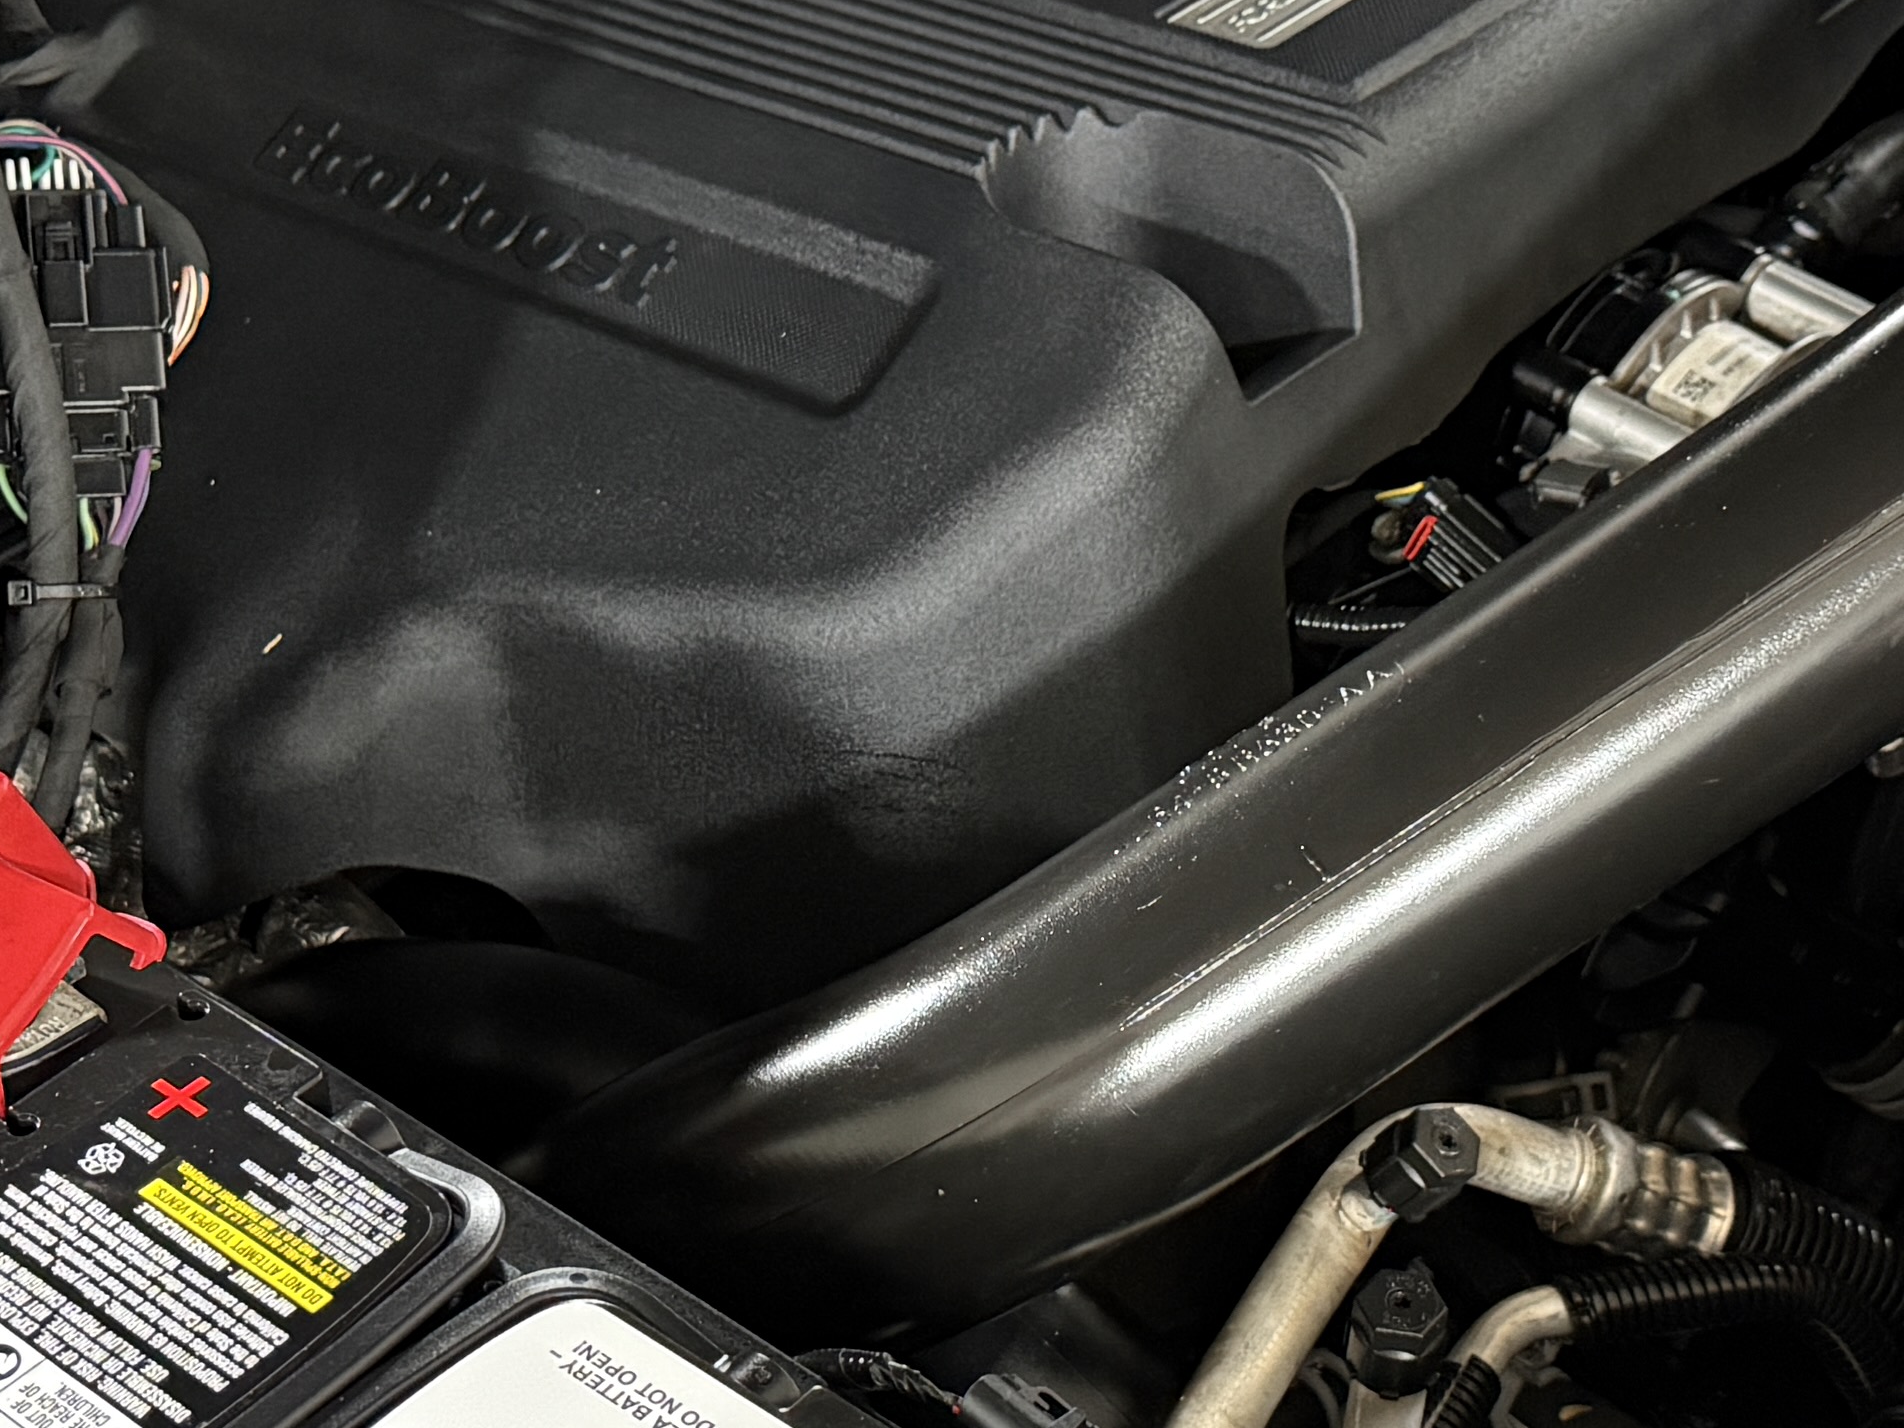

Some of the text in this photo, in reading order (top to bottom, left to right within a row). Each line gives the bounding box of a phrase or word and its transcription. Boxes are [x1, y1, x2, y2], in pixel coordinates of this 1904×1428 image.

[262, 112, 677, 310] EcoBoost
[186, 1210, 221, 1234] OPEN
[215, 1229, 236, 1246] TO
[229, 1240, 284, 1277] ATTEMPT
[277, 1273, 307, 1294] NOT
[301, 1288, 324, 1306] DO
[572, 1340, 638, 1386] OPEN!
[18, 1383, 42, 1399] OF
[559, 1360, 654, 1422] BATTERY
[634, 1383, 684, 1416] NOT
[10, 1399, 33, 1415] OF
[34, 1393, 76, 1424] REACH
